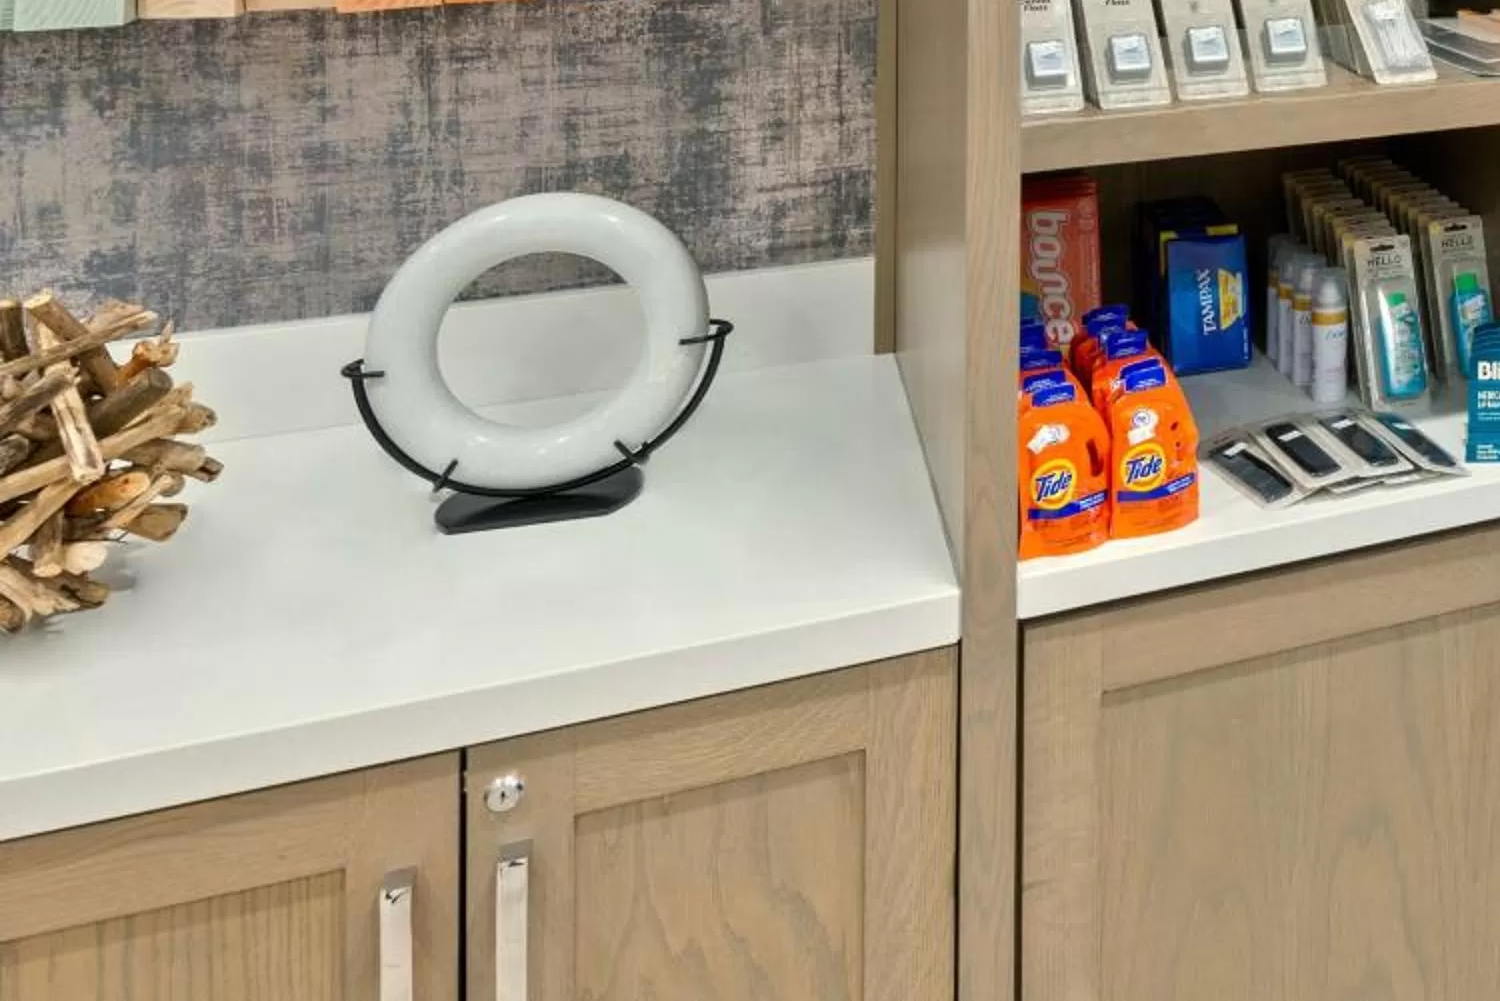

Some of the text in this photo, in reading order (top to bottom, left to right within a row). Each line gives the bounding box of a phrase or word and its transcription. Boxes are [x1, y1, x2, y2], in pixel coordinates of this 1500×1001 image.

[1027, 209, 1077, 344] bounce
[1196, 267, 1217, 336] TAMPAX
[1034, 470, 1073, 502] Tide
[1125, 455, 1163, 485] Tide
